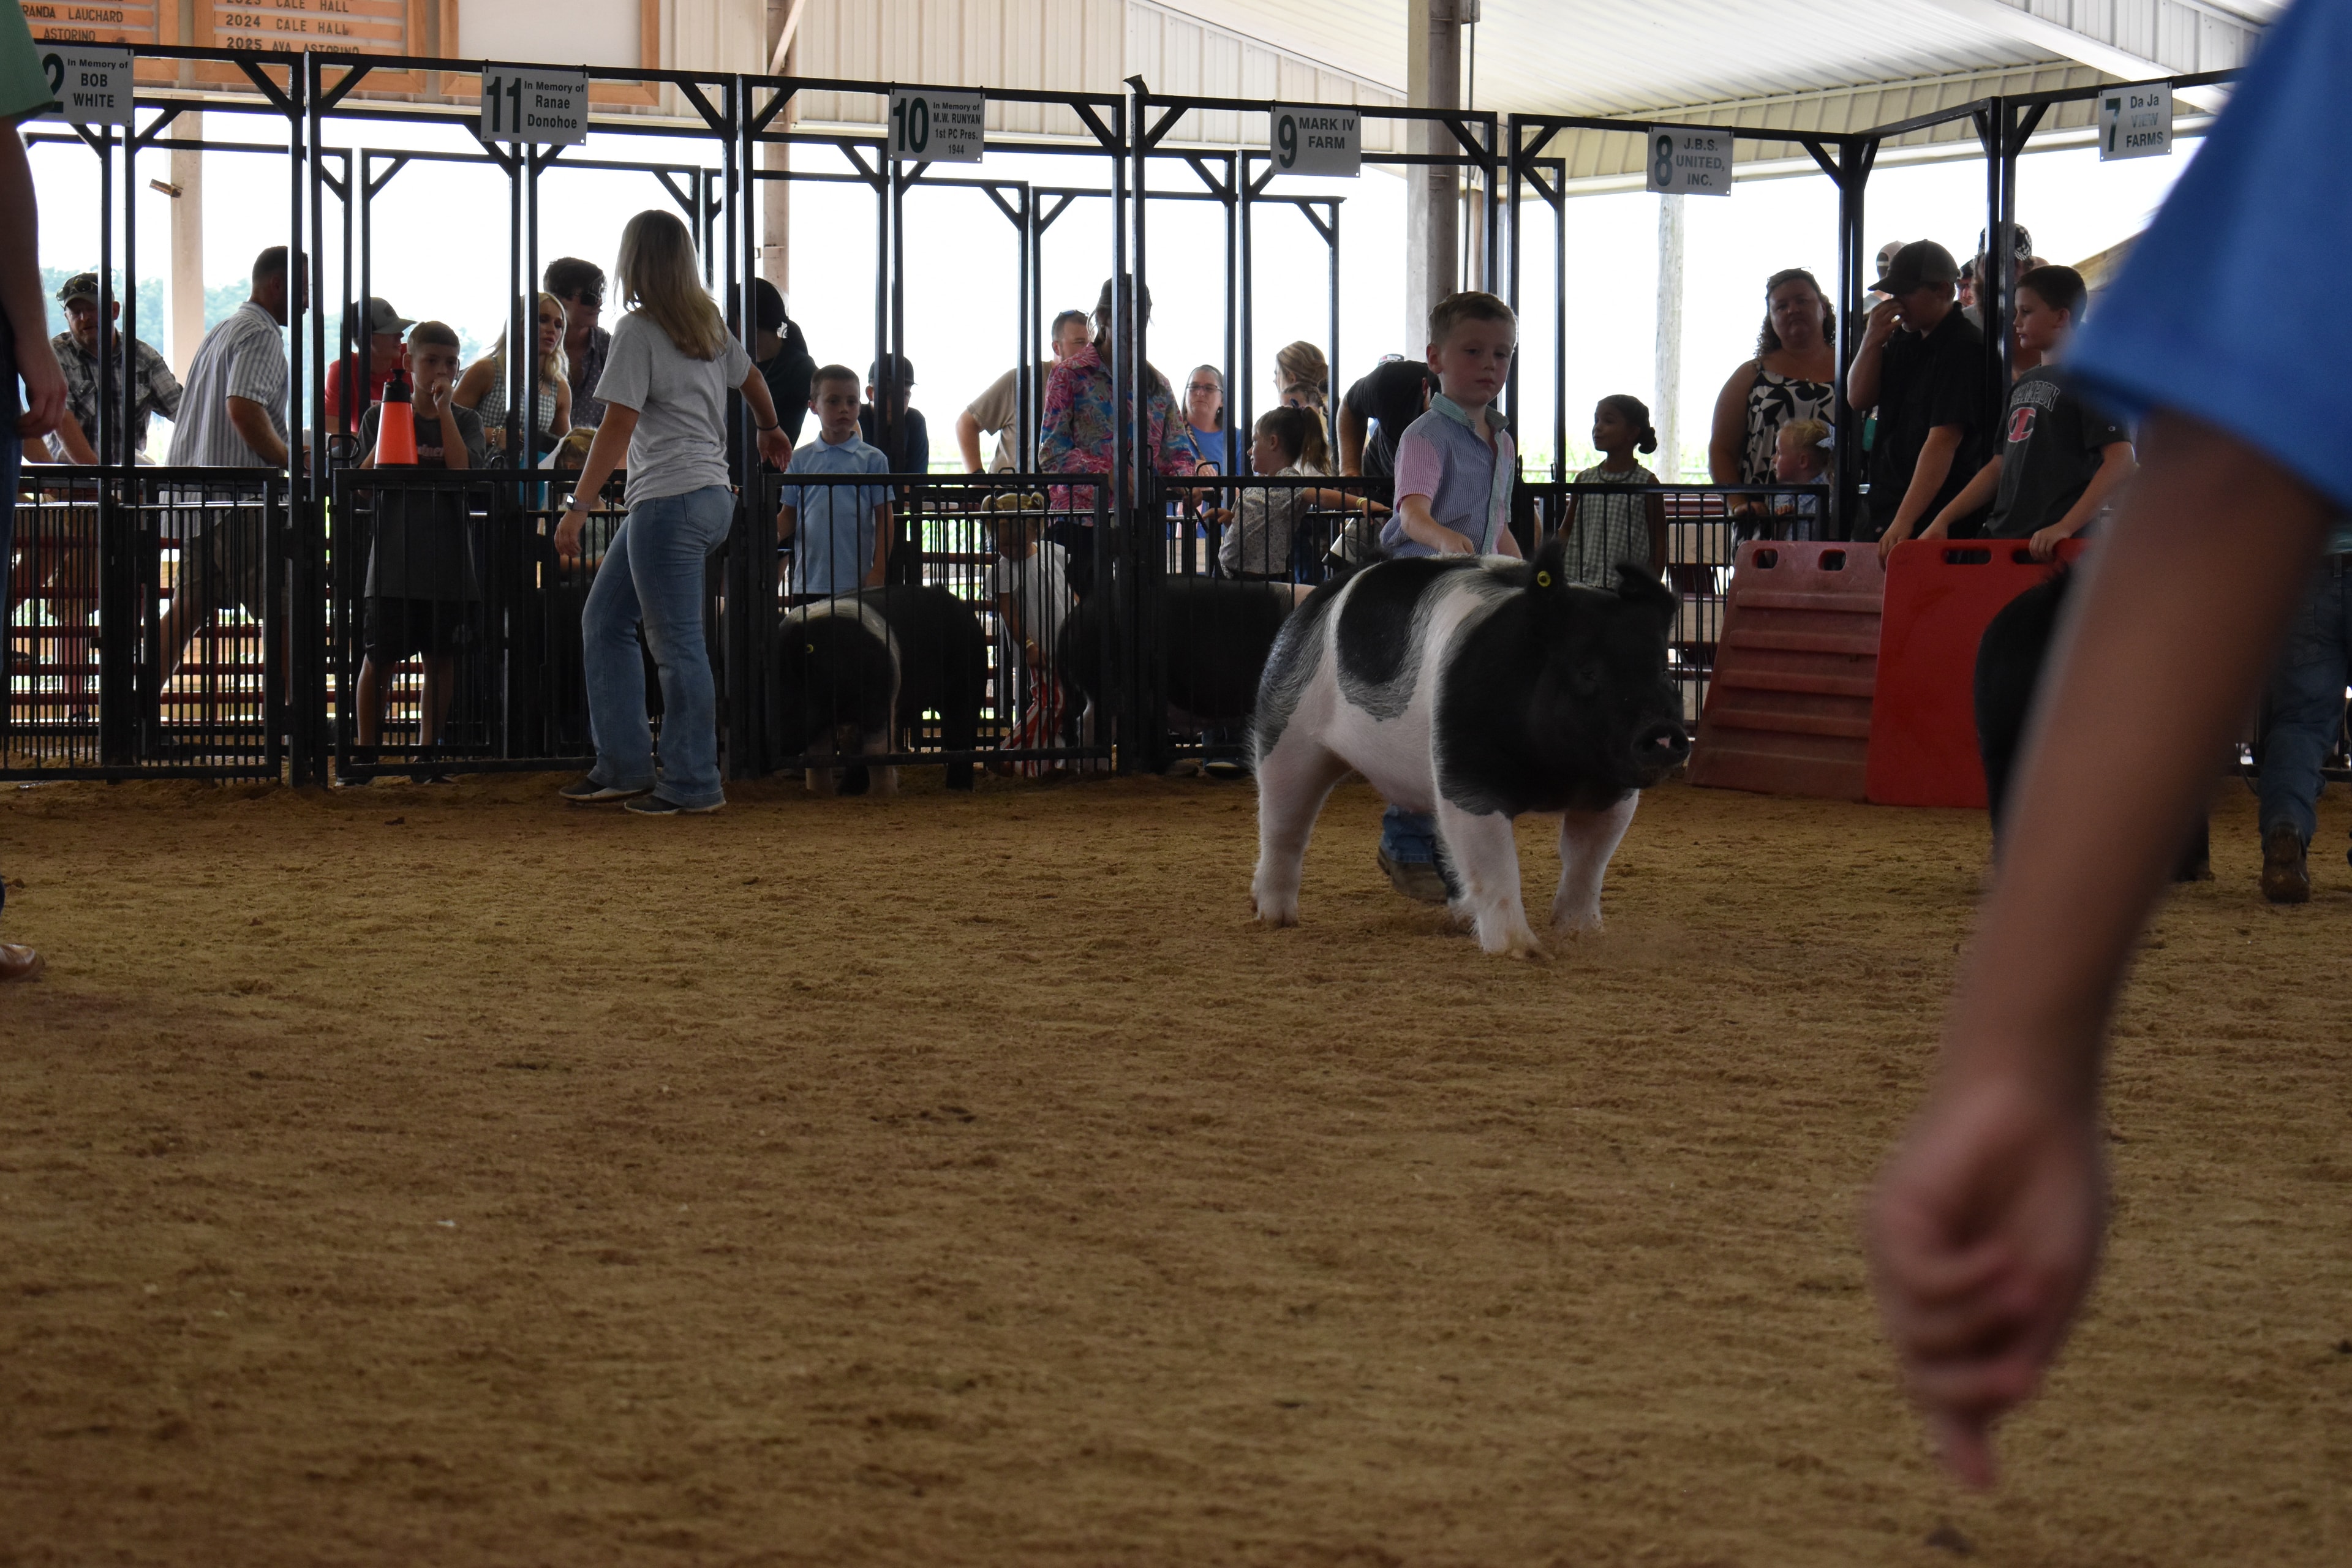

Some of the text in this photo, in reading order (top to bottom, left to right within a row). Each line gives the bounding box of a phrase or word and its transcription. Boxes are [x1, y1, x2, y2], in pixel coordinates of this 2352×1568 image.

[320, 0, 349, 12] HALL
[69, 7, 123, 23] LAUCHARD
[226, 14, 349, 36] 2024 CALE HALL
[43, 28, 96, 42] ASTORINO
[227, 37, 262, 50] 2025
[273, 40, 292, 52] AVA
[80, 59, 116, 70] Memory
[81, 73, 108, 88] BOB
[524, 81, 533, 89] In
[536, 81, 572, 94] Memory
[74, 93, 115, 108] WHITE
[486, 77, 521, 134] 11
[536, 95, 570, 109] Ranae
[942, 102, 970, 112] Memory
[2130, 94, 2159, 108] Da Ja
[527, 114, 577, 129] Donohoe
[893, 97, 929, 154] 10
[933, 113, 981, 124] M.W. RUNYAN
[1299, 117, 1355, 131] MARK IV
[2105, 97, 2121, 153] 7
[2131, 113, 2158, 127] VIEW
[935, 129, 978, 140] 1st PC Pres.
[2127, 131, 2163, 148] FARMS
[1278, 115, 1297, 169] 9
[1308, 136, 1345, 149] FARM
[1684, 138, 1718, 151] J.B.S.
[948, 145, 964, 154] 1944
[1654, 135, 1673, 187] 8
[1676, 155, 1725, 172] UNITED,
[1687, 173, 1712, 186] INC.
